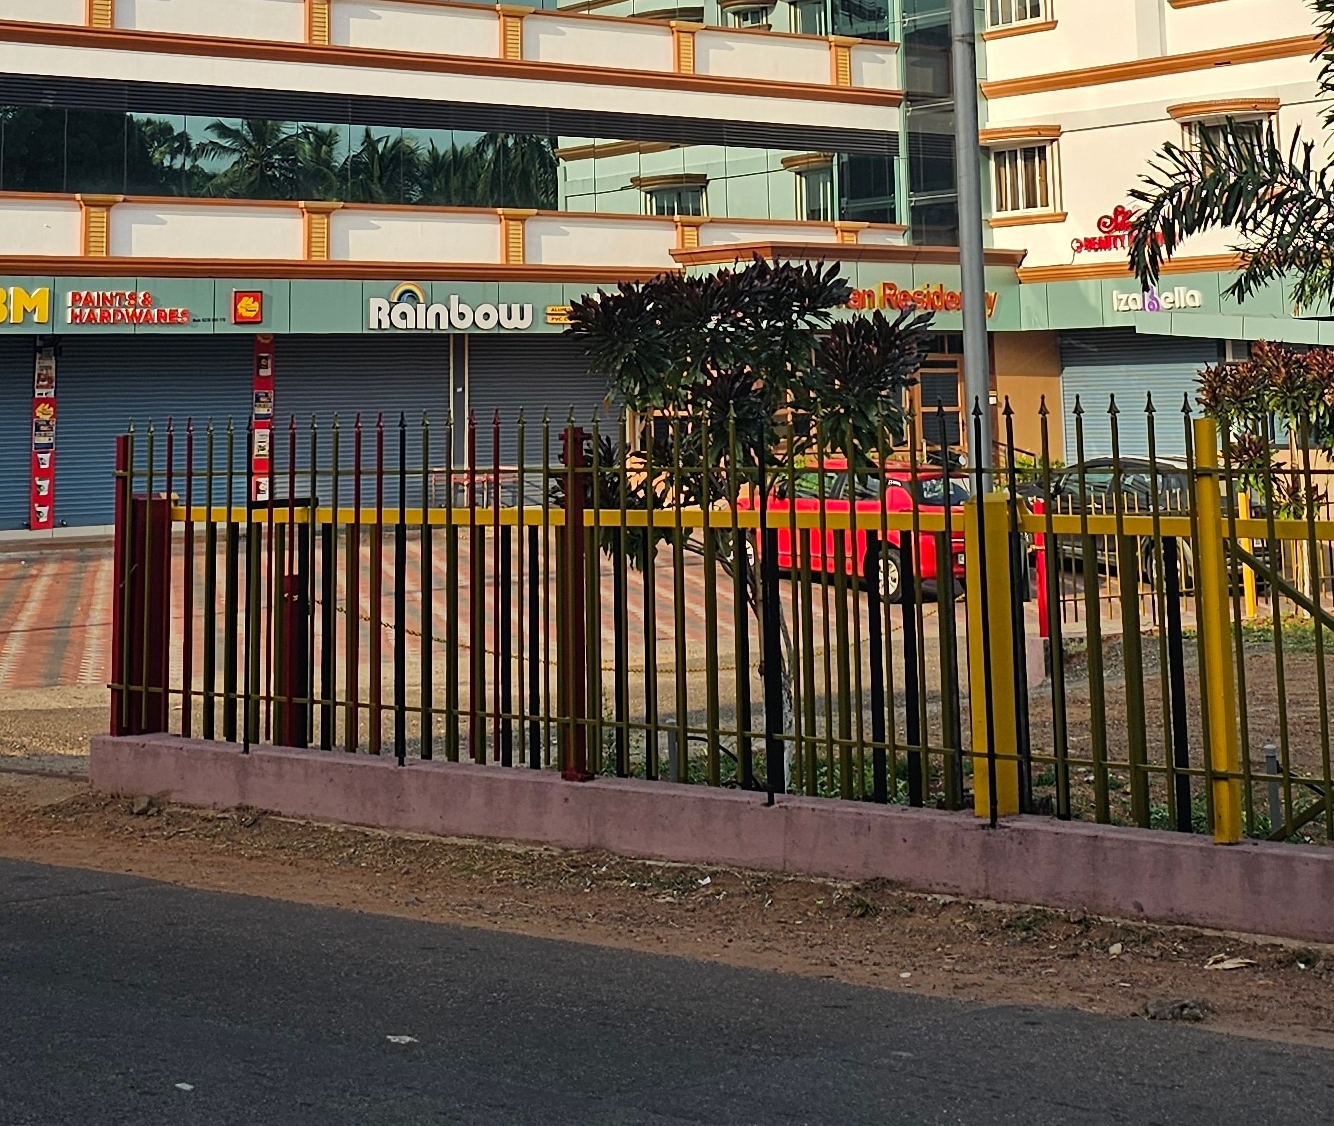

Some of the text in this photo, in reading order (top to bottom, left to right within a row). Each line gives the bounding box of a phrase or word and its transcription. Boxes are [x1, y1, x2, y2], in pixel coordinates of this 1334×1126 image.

[67, 290, 137, 307] PAINTS
[881, 282, 999, 318] Residey
[67, 307, 190, 325] HARDWARES
[369, 294, 534, 331] Rainbow
